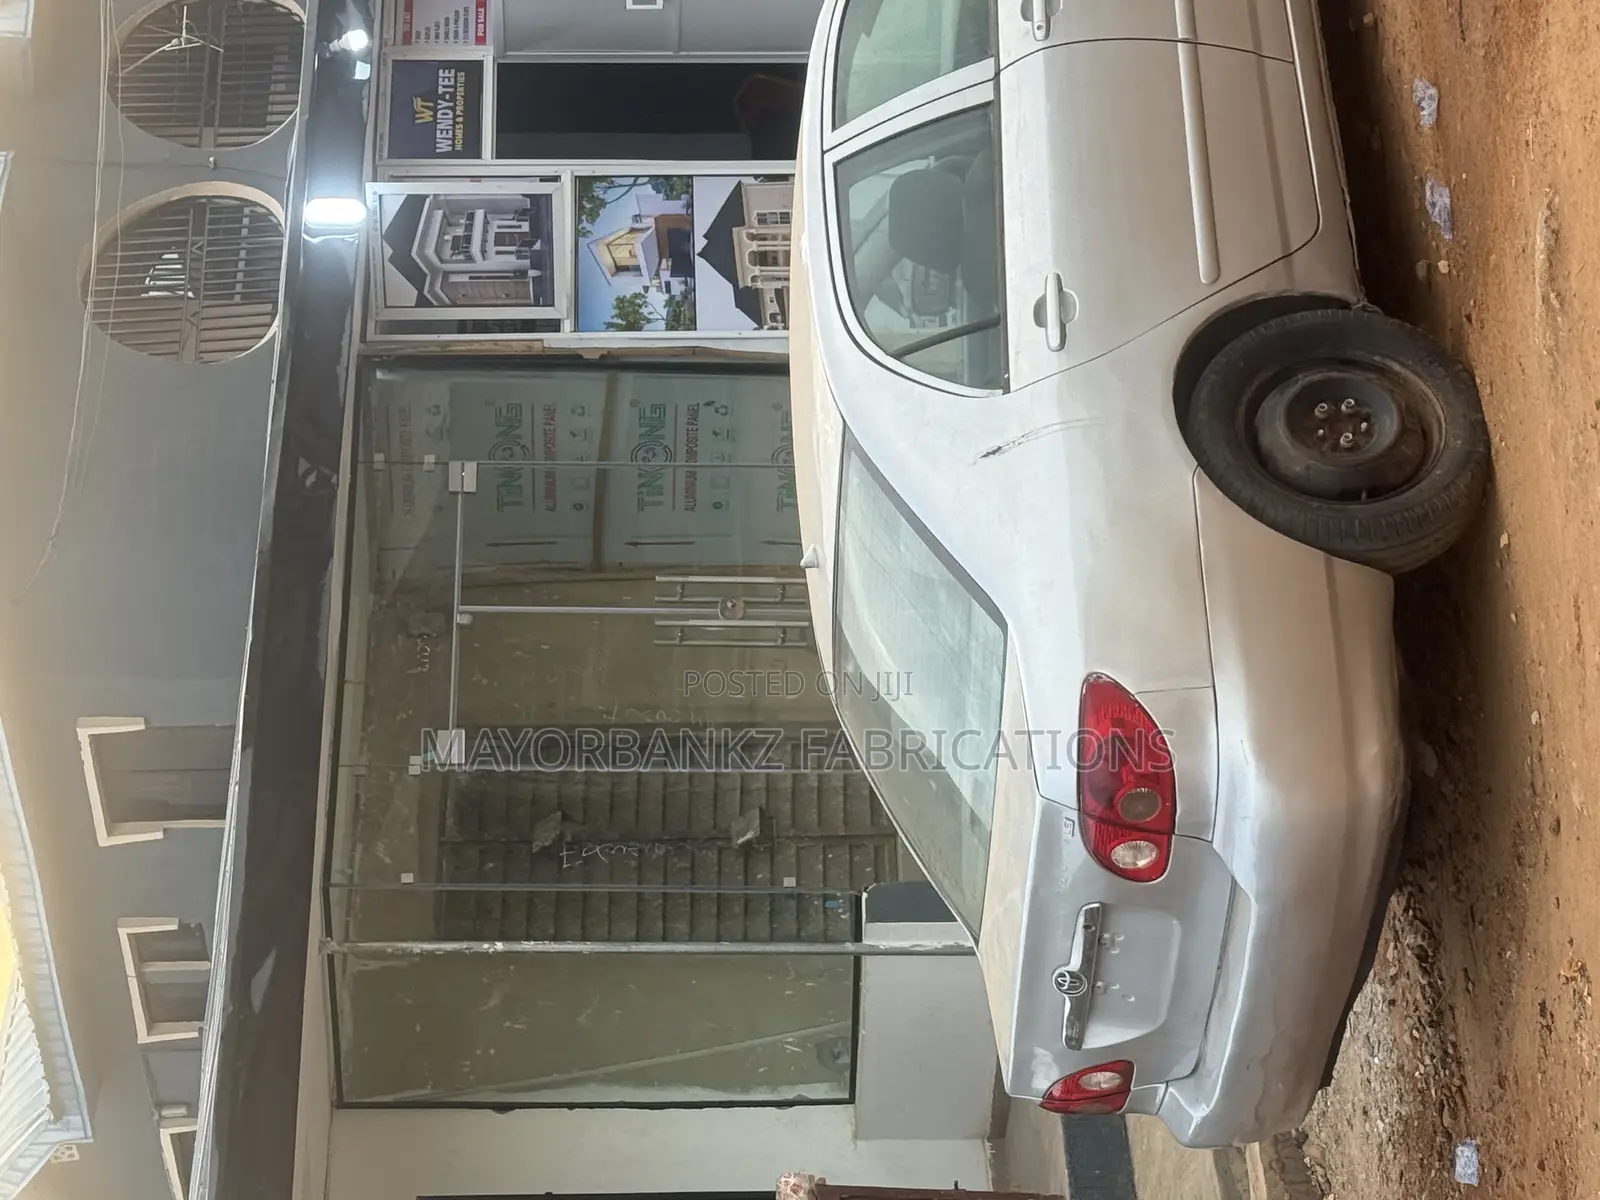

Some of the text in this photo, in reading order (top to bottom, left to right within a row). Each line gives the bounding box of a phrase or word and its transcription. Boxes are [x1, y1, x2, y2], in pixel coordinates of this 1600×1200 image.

[435, 69, 455, 153] WENDY-TEE
[456, 72, 465, 115] PROPERTIES
[455, 123, 463, 151] HOMES
[686, 402, 700, 426] PANEL
[544, 471, 556, 512] ALUMINIUM
[685, 470, 698, 512] ALUMINIUM
